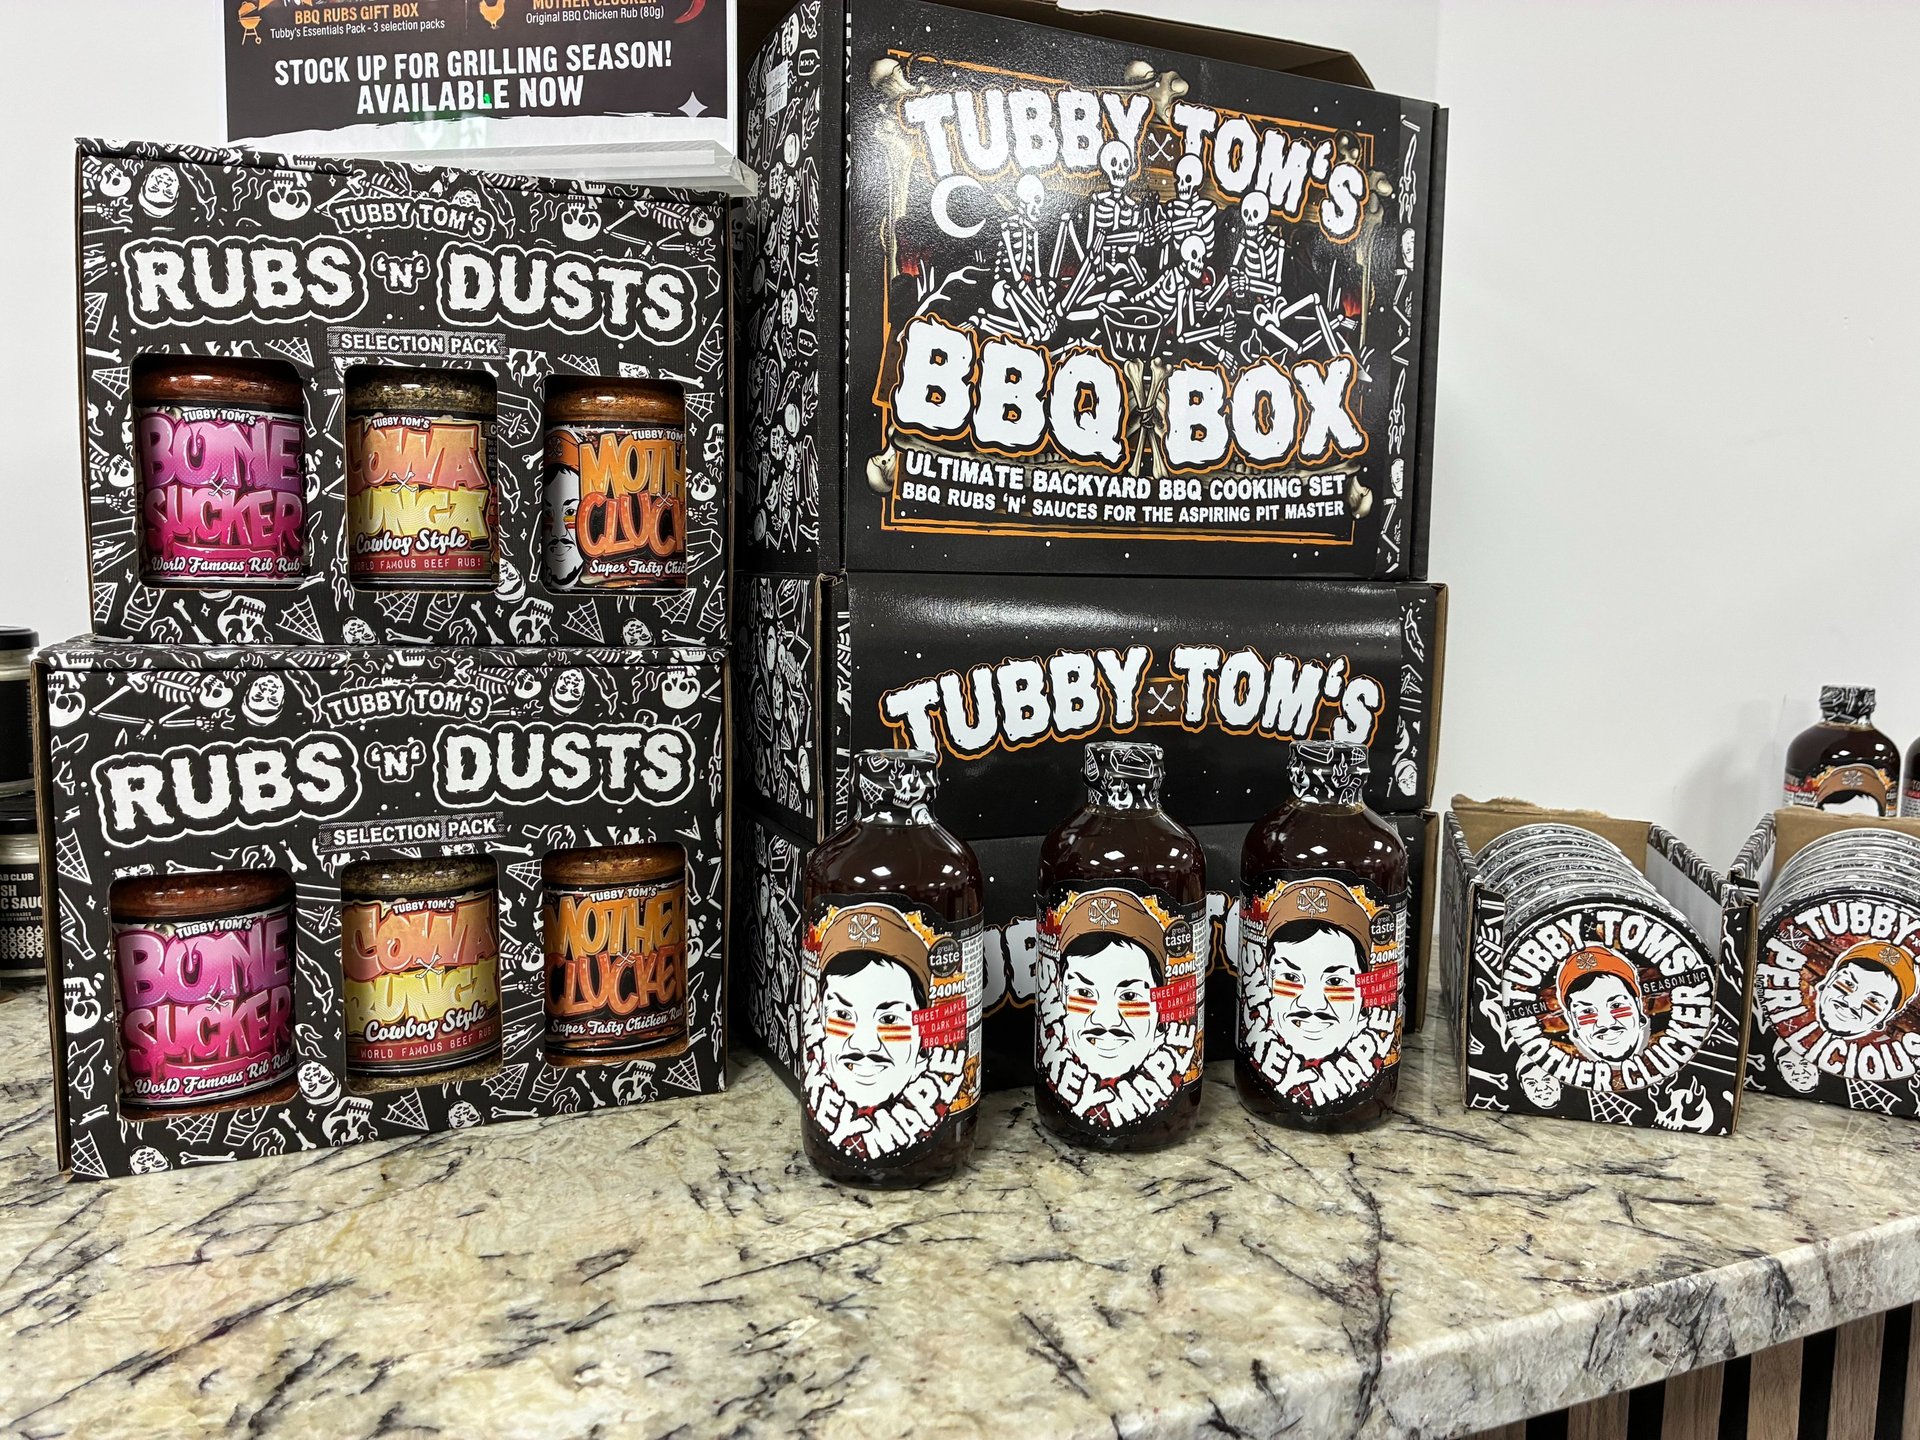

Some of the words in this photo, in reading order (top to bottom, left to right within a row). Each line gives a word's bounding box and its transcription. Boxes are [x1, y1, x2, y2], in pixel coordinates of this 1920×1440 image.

[295, 10, 320, 25] BBQ
[324, 7, 357, 23] RUBS
[361, 5, 389, 20] GIFT
[393, 2, 419, 18] BOX
[526, 10, 560, 25] Original
[562, 10, 581, 22] BBQ
[583, 8, 618, 21] Chicken
[621, 7, 637, 19] Rub
[640, 6, 664, 20] (80g)
[270, 27, 301, 41] Tubby's
[303, 24, 344, 37] Essentials
[346, 21, 366, 34] Pack
[373, 21, 379, 33] 3
[380, 19, 418, 33] selection
[420, 18, 445, 32] packs
[275, 57, 350, 86] STOCK
[357, 55, 387, 82] UP
[394, 52, 439, 80] FOR
[447, 46, 558, 77] GRILLING
[566, 40, 672, 72] SEASON!
[356, 79, 510, 115] AVAILABLE
[519, 75, 584, 108] NOW
[905, 87, 1150, 175] TUBBY
[1173, 102, 1364, 235] TOM'S
[335, 202, 411, 228] TUBBY
[419, 203, 486, 237] TOM'S
[133, 245, 354, 312] RUBS
[448, 250, 685, 332] DUSTS
[341, 333, 444, 353] SELECTION
[450, 337, 500, 354] PACK
[898, 319, 1122, 465] BBQ
[1165, 360, 1363, 465] BOX
[183, 408, 218, 424] TUBBY
[373, 416, 399, 429] TUBBY
[631, 430, 664, 441] TUBBY
[141, 415, 302, 492] BONE
[906, 450, 1025, 491] ULTIMATE
[1032, 470, 1151, 499] BACKYARD
[1158, 477, 1202, 501] BBQ
[1209, 478, 1301, 501] COOKING
[1308, 474, 1346, 496] SET
[902, 481, 941, 504] BBQ
[947, 488, 996, 511] RUBS
[1032, 500, 1098, 520] SAUCES
[1103, 504, 1136, 522] FOR
[1142, 506, 1174, 523] THE
[1178, 505, 1251, 523] ASPIRING
[1256, 504, 1279, 521] PIT
[1284, 500, 1345, 521] MASTER
[145, 486, 303, 550] SUCKER
[356, 532, 413, 556] Cowboy
[416, 528, 468, 554] Style
[152, 557, 186, 571] World
[188, 557, 245, 573] Famous
[250, 557, 273, 572] Rib
[277, 557, 300, 572] Rub
[380, 558, 417, 570] FAMOUS
[424, 557, 450, 569] BEEF
[589, 559, 627, 577] Super
[629, 560, 664, 577] Tasty
[326, 689, 407, 721] TUBBY
[414, 688, 484, 716] TOM'S
[886, 645, 1149, 755] TUBBY
[1174, 645, 1380, 744] TOM'S
[105, 741, 356, 831] RUBS
[443, 731, 685, 793] DUSTS
[333, 821, 441, 847] SELECTION
[447, 818, 497, 836] PACK
[10, 872, 35, 881] CLUB
[392, 901, 427, 914] TUBBY
[590, 889, 626, 903] TUBBY
[176, 920, 215, 940] TUBBY
[1370, 922, 1395, 935] taste
[1794, 900, 1920, 946] TUBBY
[342, 892, 498, 983] COWA
[1164, 932, 1191, 947] taste
[118, 917, 290, 1009] BONE
[929, 950, 960, 967] taste
[1503, 911, 1586, 1007] TUBBY
[929, 979, 967, 1000] 240ML
[1356, 973, 1379, 986] SWEET
[1371, 983, 1387, 994] DARK
[1642, 970, 1708, 993] SEASONING
[1151, 987, 1175, 1001] SWEET
[1167, 996, 1184, 1009] DARK
[365, 1017, 439, 1042] Cowboy
[441, 1001, 487, 1032] Style
[551, 1018, 587, 1036] Super
[587, 1020, 624, 1036] Tasty
[625, 1012, 668, 1033] Chicken
[913, 1009, 940, 1024] SWEET
[943, 999, 966, 1017] MAPLE
[931, 1019, 950, 1032] DARK
[954, 1013, 966, 1025] ALE
[125, 986, 293, 1066] SUCKER
[943, 1031, 965, 1043] GLAZE
[1507, 1017, 1614, 1091] MOTHER
[1621, 981, 1713, 1091] CLUCKER
[361, 1047, 394, 1059] WORLD
[401, 1041, 443, 1057] FAMOUS
[450, 1033, 473, 1049] BEEF
[1311, 1008, 1397, 1107] MAPLE
[135, 1079, 180, 1095] World
[183, 1071, 244, 1094] Famous
[247, 1059, 269, 1079] Rib
[1108, 1022, 1197, 1128] MAPLE
[866, 1047, 967, 1159] MAPLE
